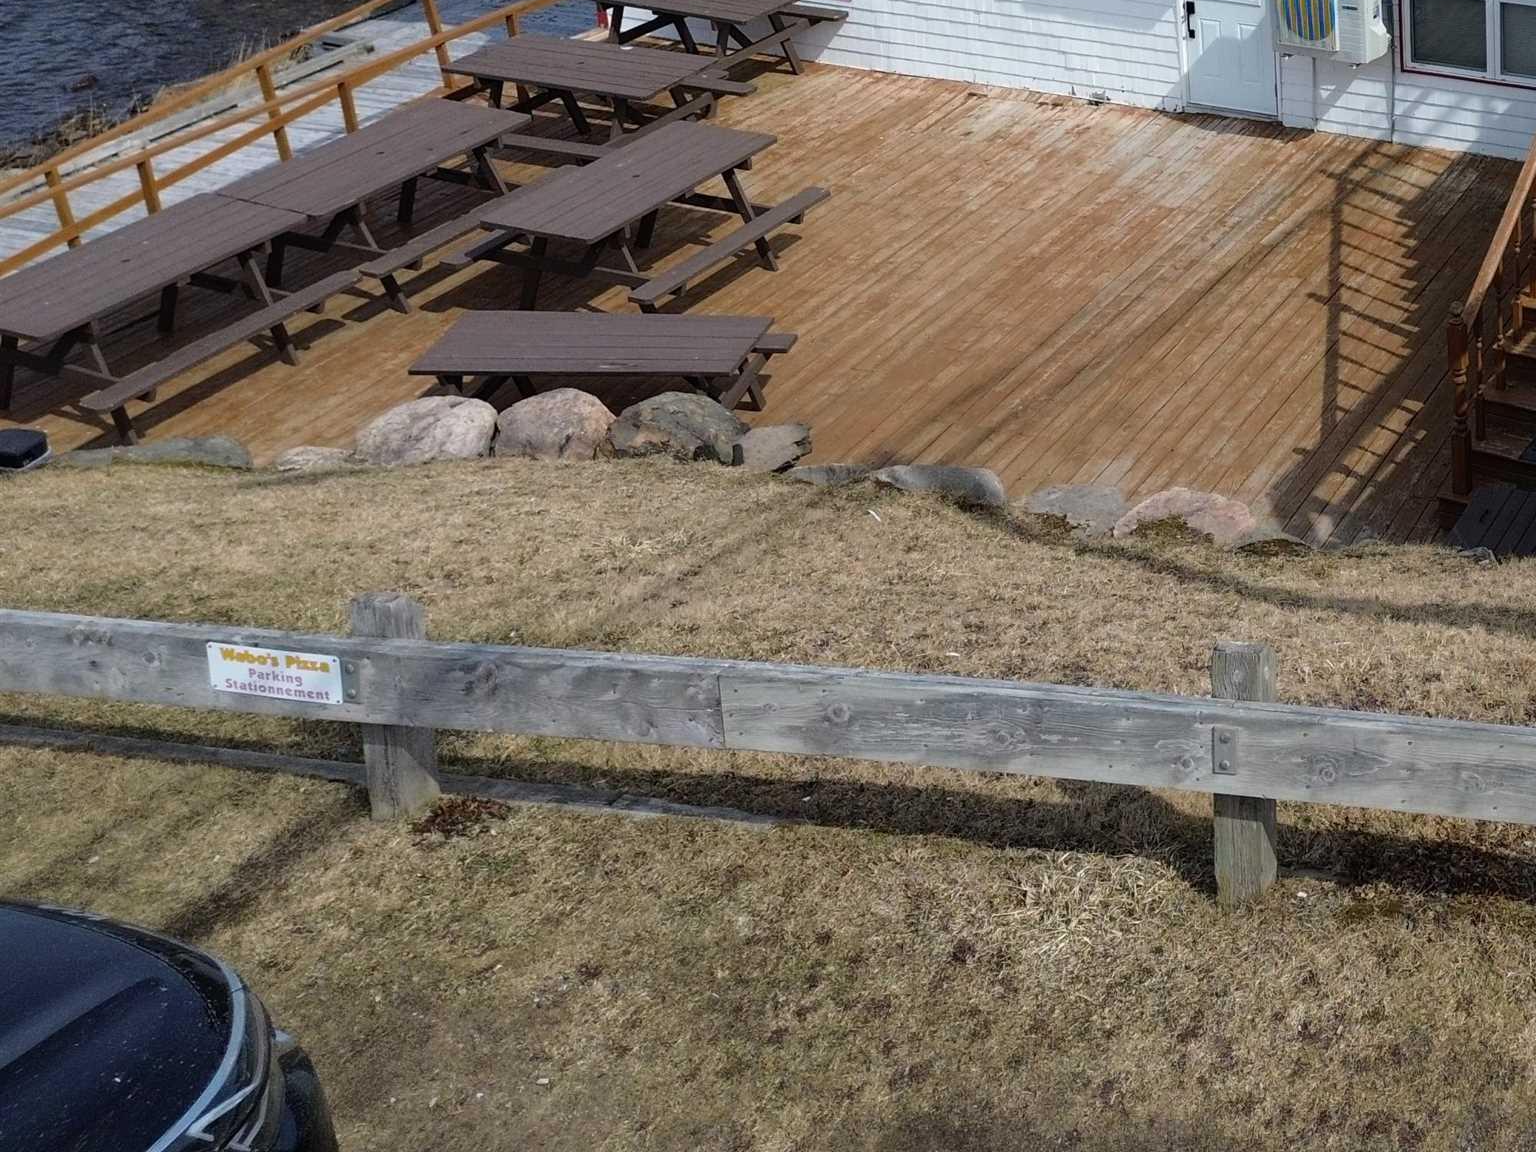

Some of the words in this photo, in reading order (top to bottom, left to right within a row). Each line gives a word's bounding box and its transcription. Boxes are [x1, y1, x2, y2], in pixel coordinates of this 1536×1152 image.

[219, 647, 280, 668] Wabo's
[285, 654, 331, 673] Pizza
[248, 667, 304, 687] Parking
[224, 678, 331, 701] Stationnement
